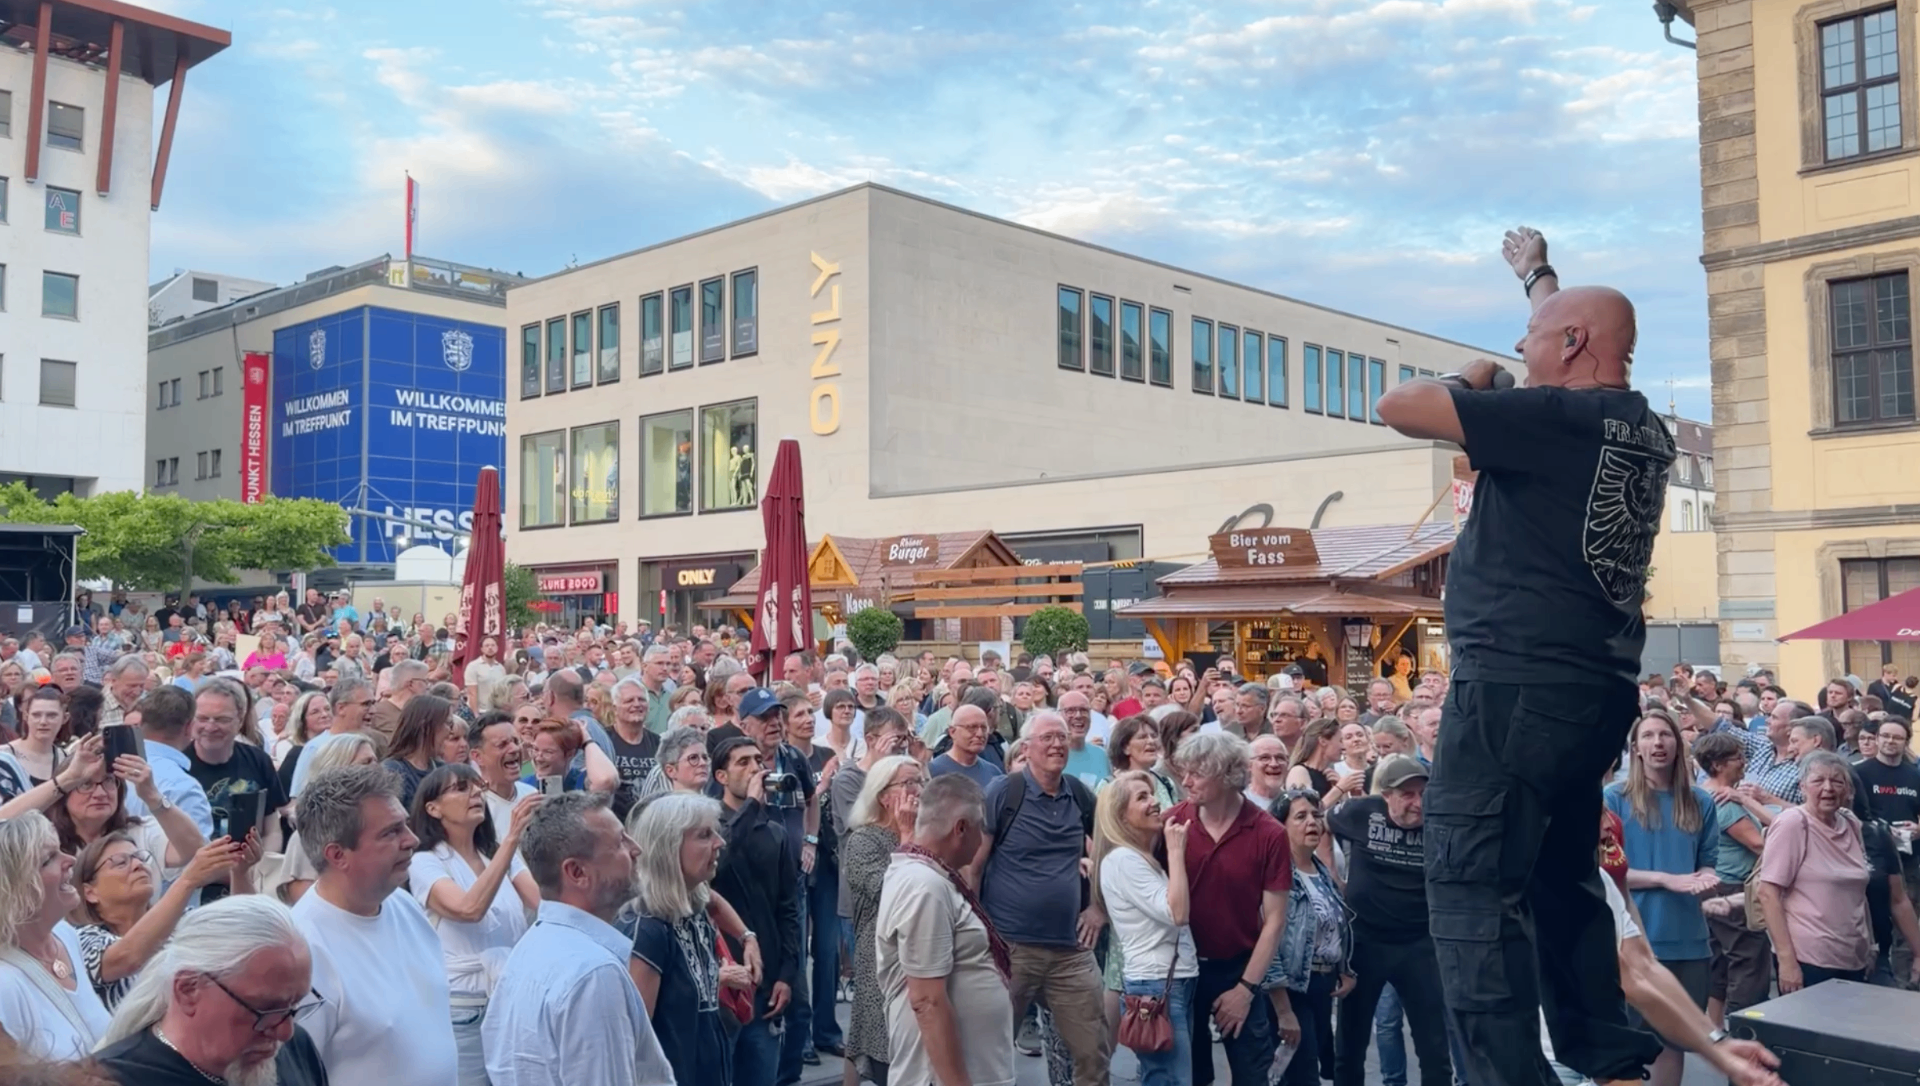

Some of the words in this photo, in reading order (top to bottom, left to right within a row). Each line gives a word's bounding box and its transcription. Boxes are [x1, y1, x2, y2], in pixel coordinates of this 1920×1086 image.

[49, 192, 66, 211] A
[60, 211, 75, 229] E
[810, 250, 841, 436] ONLY
[285, 389, 349, 416] WILLKOMMEN
[395, 389, 506, 417] WILLKOMME
[282, 422, 294, 437] IM
[295, 410, 352, 435] TREFFPUNKT
[391, 410, 413, 427] IM
[248, 405, 262, 456] HESSEN
[385, 506, 506, 540] HESS
[1230, 534, 1258, 547] Bier
[1262, 535, 1291, 546] vom
[889, 544, 930, 564] Burger
[1247, 549, 1285, 565] Fass
[568, 577, 596, 590] 2000
[678, 569, 716, 586] ONLY
[1368, 825, 1403, 844] CAMP
